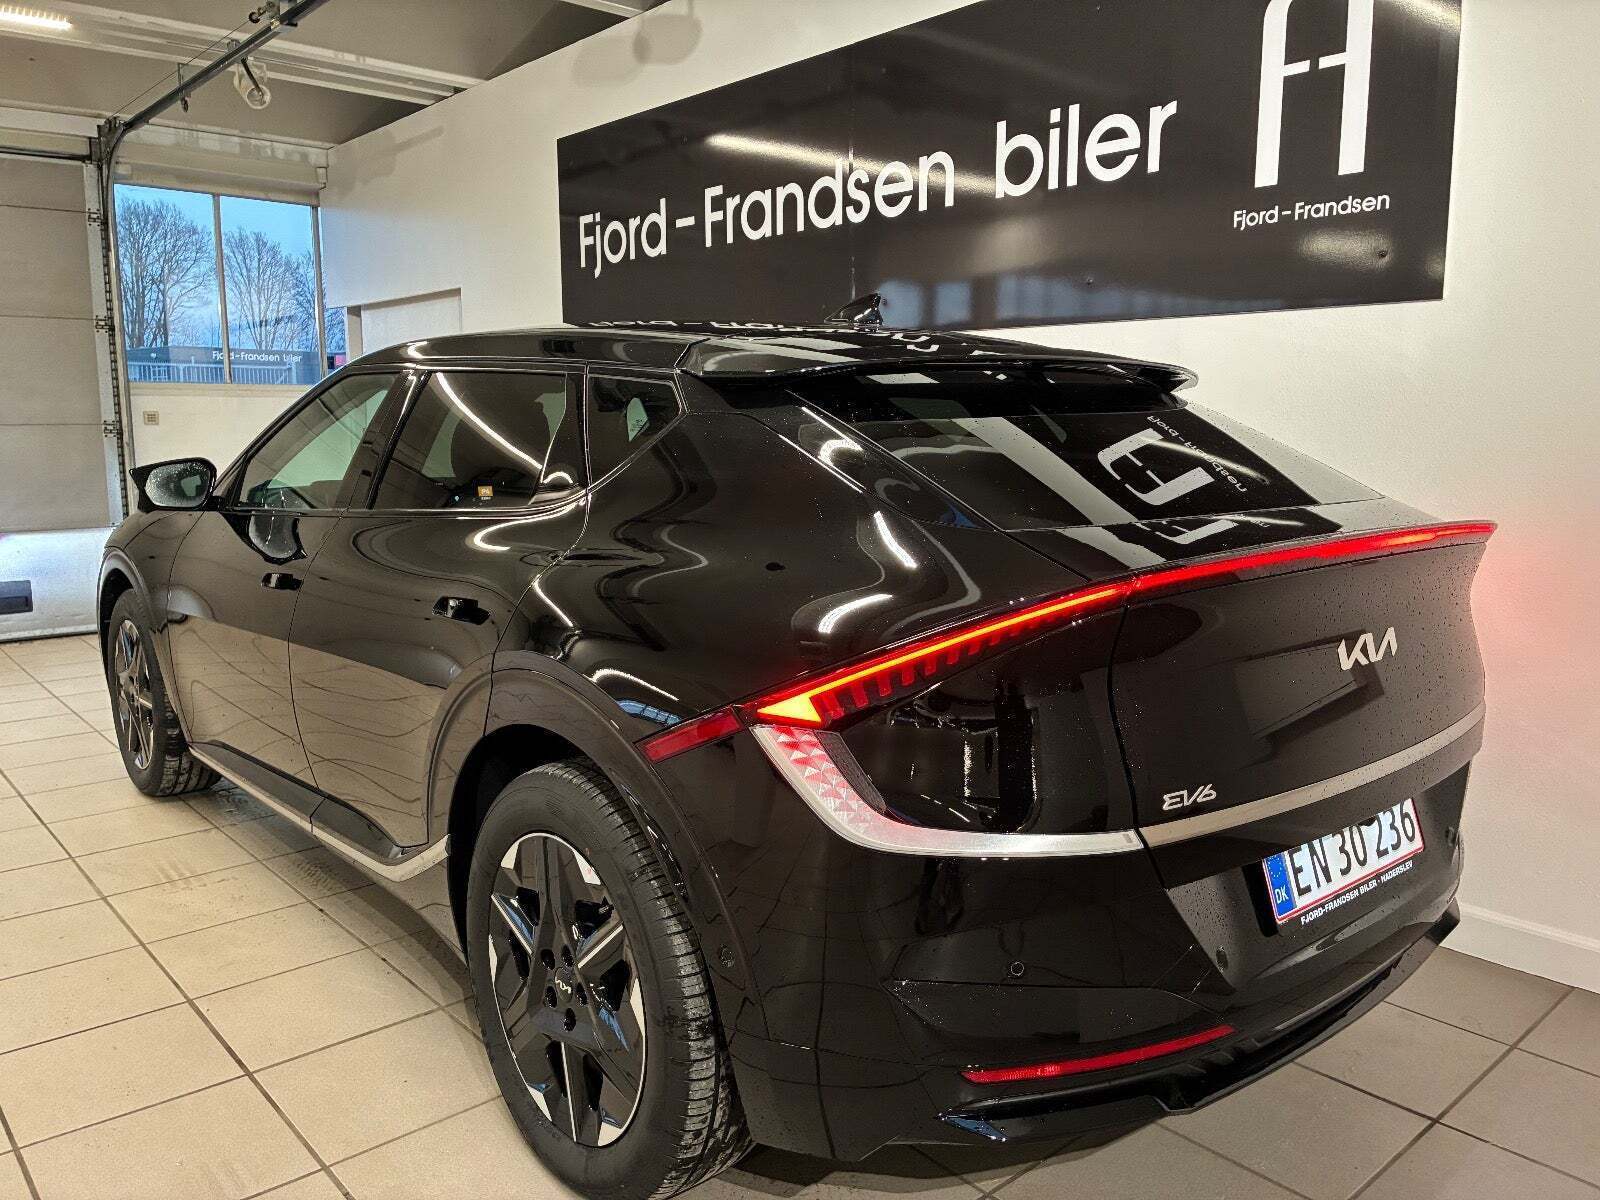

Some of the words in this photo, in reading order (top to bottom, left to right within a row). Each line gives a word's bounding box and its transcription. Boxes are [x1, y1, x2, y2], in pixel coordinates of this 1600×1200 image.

[995, 100, 1178, 199] biler
[1162, 784, 1217, 810] EV6
[1288, 838, 1332, 896] EN
[1332, 825, 1367, 876] 30
[1374, 801, 1415, 858] 236
[1274, 886, 1289, 904] DK
[1300, 889, 1359, 925] FJORD-FRANDSEN
[1359, 880, 1378, 895] BILER
[1380, 860, 1413, 884] HADERSLEV
